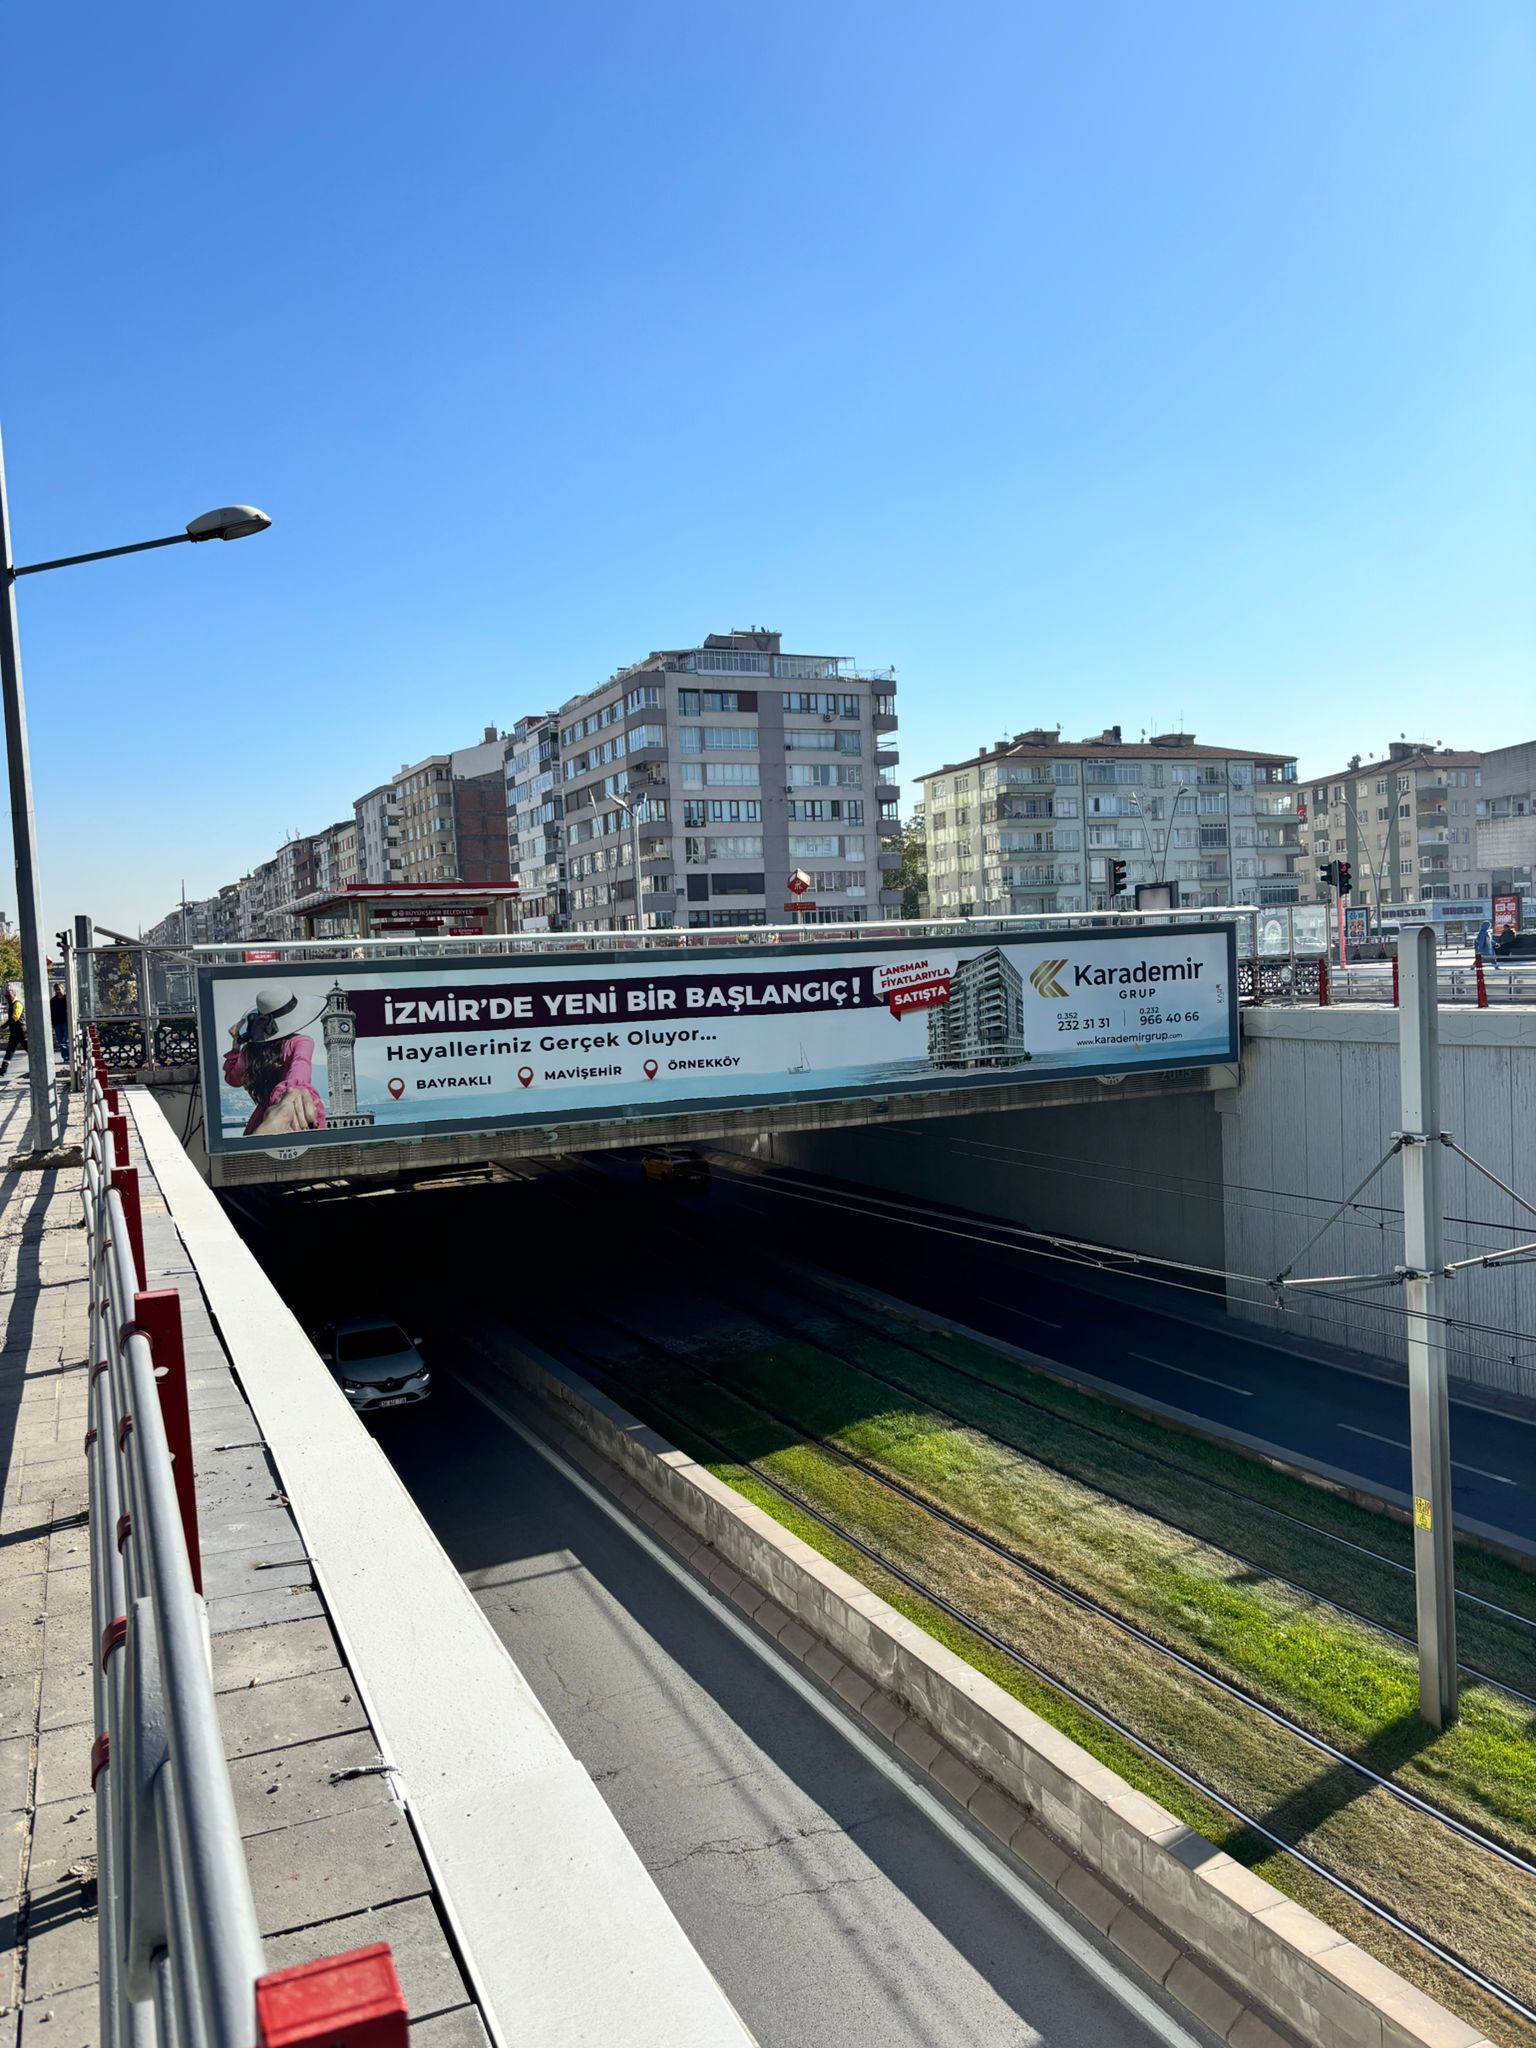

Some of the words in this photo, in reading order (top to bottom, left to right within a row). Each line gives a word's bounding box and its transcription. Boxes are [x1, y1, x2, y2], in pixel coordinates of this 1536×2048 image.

[879, 960, 928, 977] LANSMAN
[1073, 957, 1203, 986] Karademir
[881, 967, 950, 988] FİYATLARIYLA
[542, 986, 617, 1016] YENİ
[627, 984, 677, 1012] BİR
[686, 976, 861, 1012] BAŞLANGIÇ!
[894, 985, 947, 1005] SATIŞTA
[1119, 988, 1156, 999] GRUP
[1057, 1012, 1078, 1020] 0.352
[1058, 1020, 1079, 1031] 232
[1083, 1019, 1095, 1029] 31
[1098, 1017, 1110, 1028] 31
[1140, 1014, 1162, 1026] 966
[1166, 1013, 1181, 1023] 40
[1184, 1011, 1199, 1022] 66
[387, 1037, 532, 1063] Hayalleriniz
[540, 1032, 620, 1052] Gerçek
[627, 1029, 717, 1048] Oluyor...
[1076, 1031, 1183, 1046] www.karademirgrup.com
[668, 1056, 741, 1070] ÖRNEKKÖY
[544, 1064, 622, 1081] MAVİŞEHİR
[416, 1075, 492, 1089] BAYRAKLI
